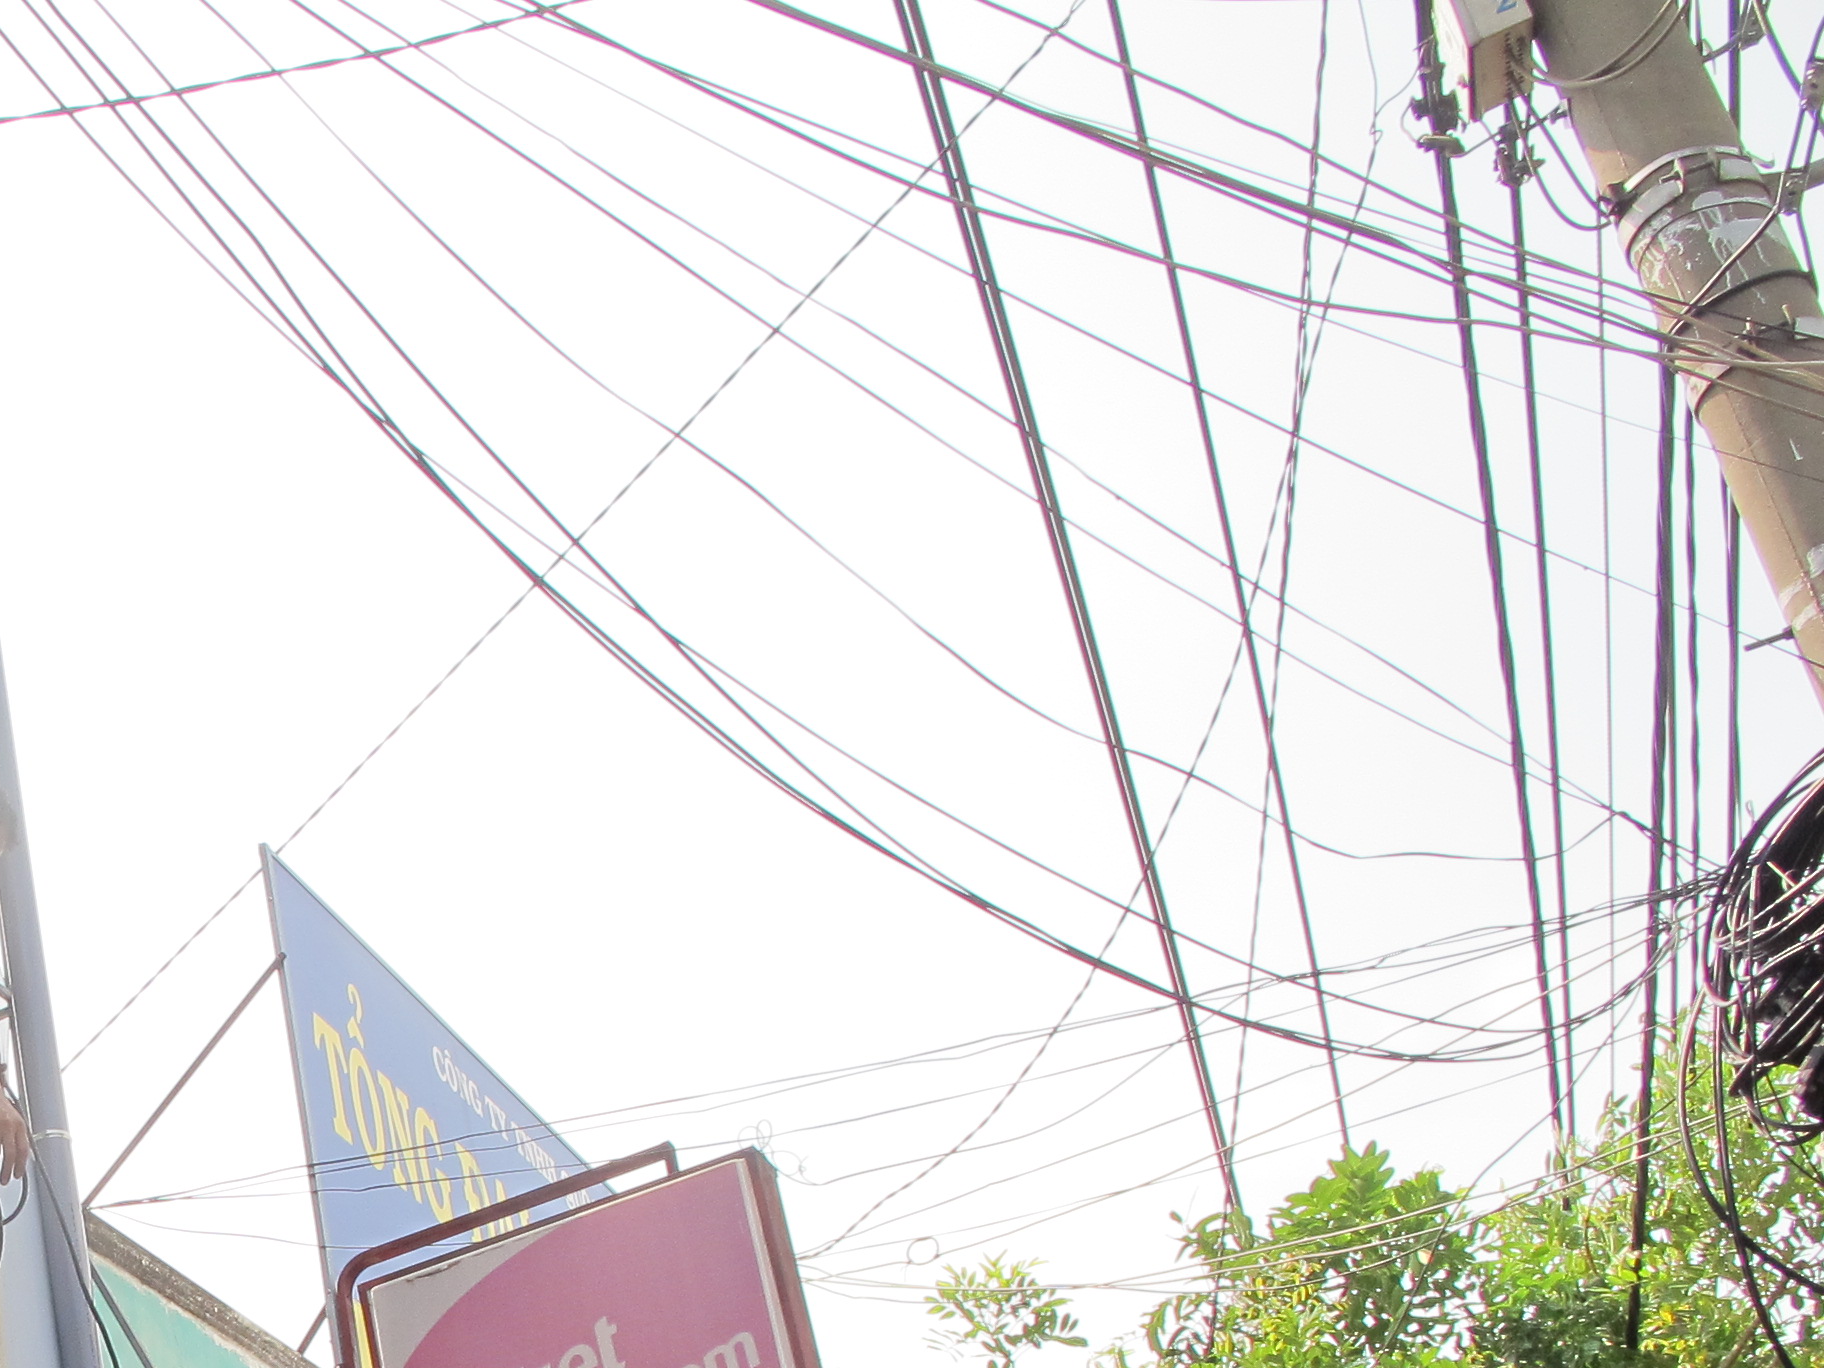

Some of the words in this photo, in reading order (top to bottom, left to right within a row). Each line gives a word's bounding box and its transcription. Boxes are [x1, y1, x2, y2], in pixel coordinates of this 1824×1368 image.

[312, 983, 455, 1224] TỔNG
[432, 1046, 484, 1119] CÔNG
[484, 1095, 509, 1142] TY
